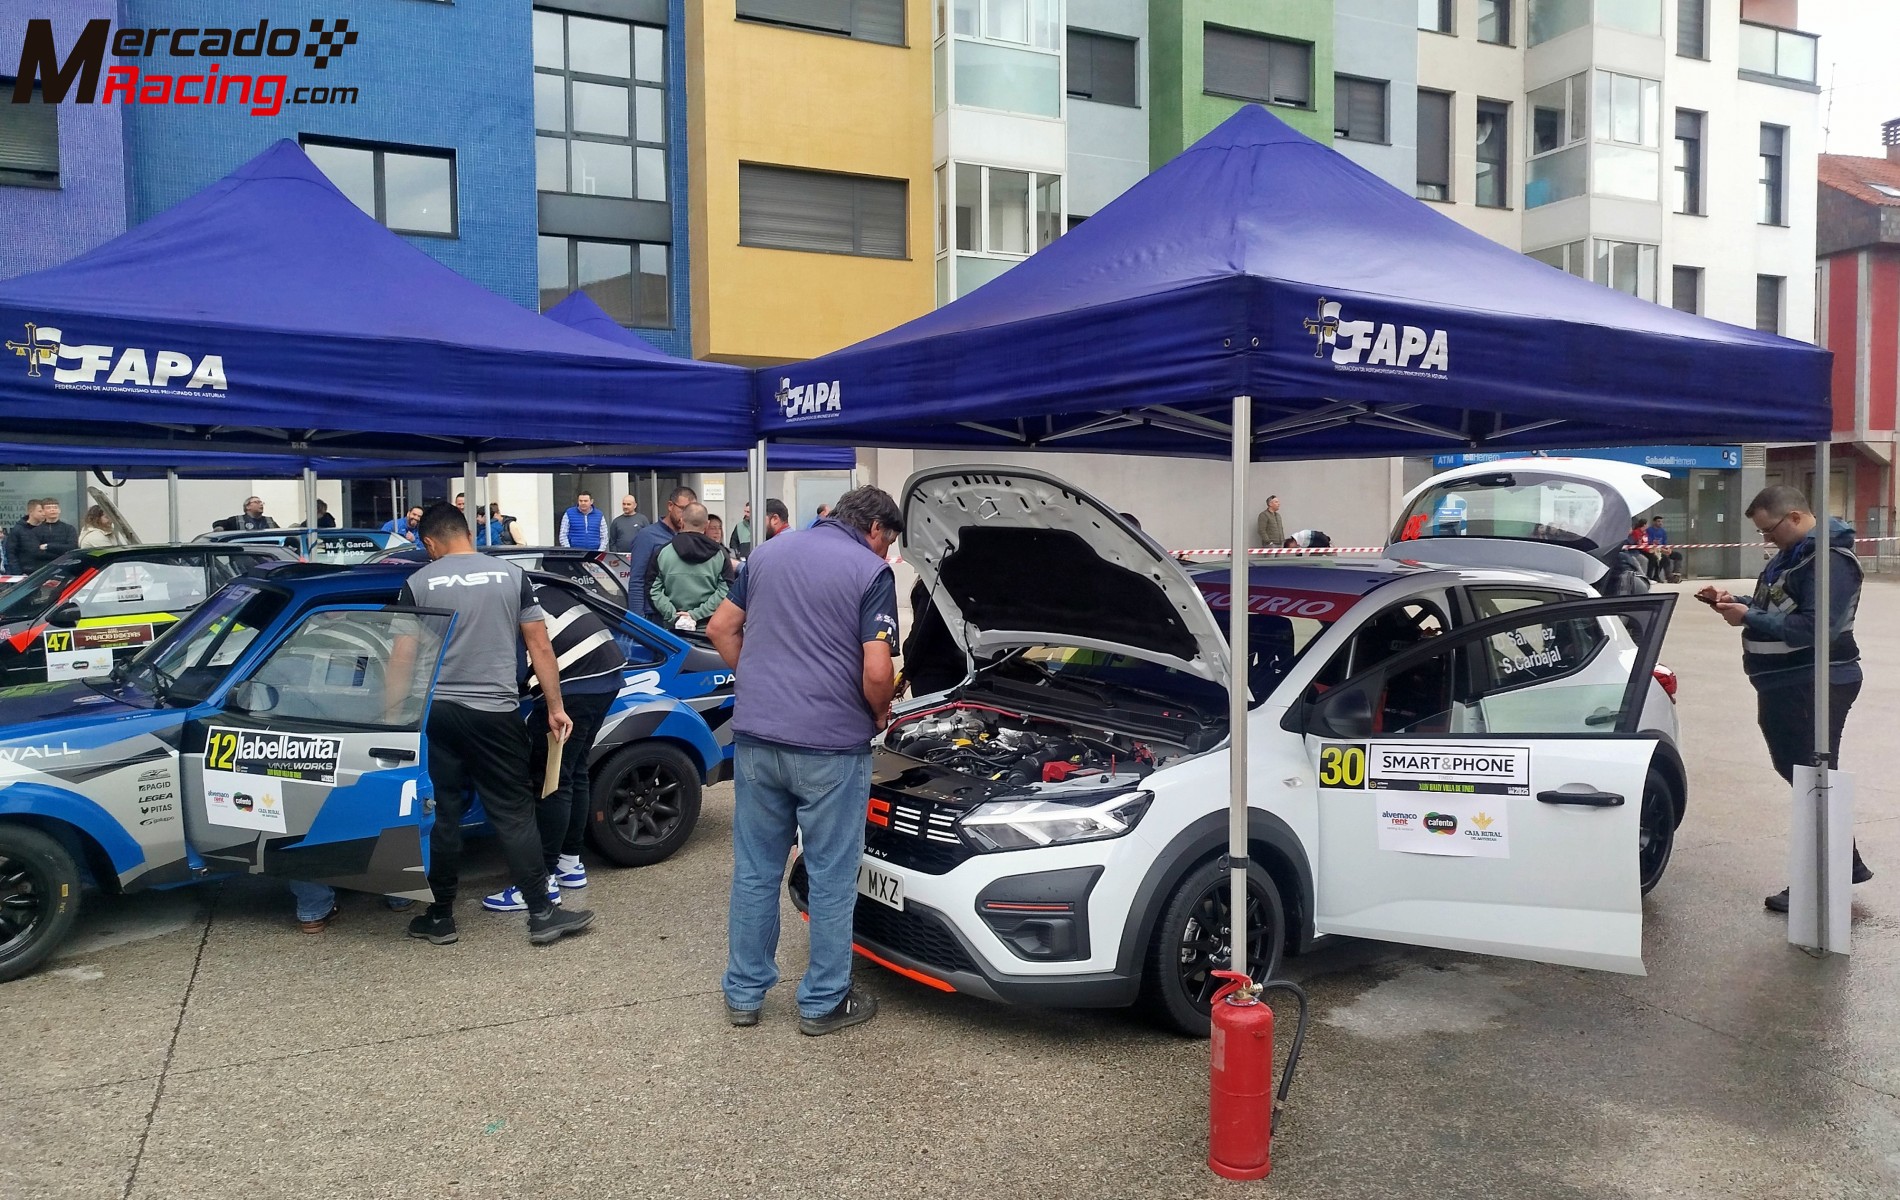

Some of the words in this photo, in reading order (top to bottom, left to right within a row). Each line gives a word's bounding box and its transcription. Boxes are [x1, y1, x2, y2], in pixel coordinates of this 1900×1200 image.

[1348, 320, 1449, 371] FAPA
[80, 344, 228, 390] FAPA
[795, 380, 842, 414] FAPA
[1438, 456, 1454, 465] ATM
[346, 540, 374, 549] García
[428, 571, 510, 591] PAST
[47, 632, 70, 651] 47
[1502, 645, 1562, 674] S.Carbajal
[209, 733, 237, 769] 12
[1320, 747, 1365, 787] 30
[1383, 755, 1514, 773] SMART&PHONE
[146, 781, 171, 791] PAGID
[138, 792, 173, 804] LEGEA
[150, 803, 173, 813] PITAS
[1427, 819, 1454, 828] cafento
[868, 868, 899, 906] MXZ
